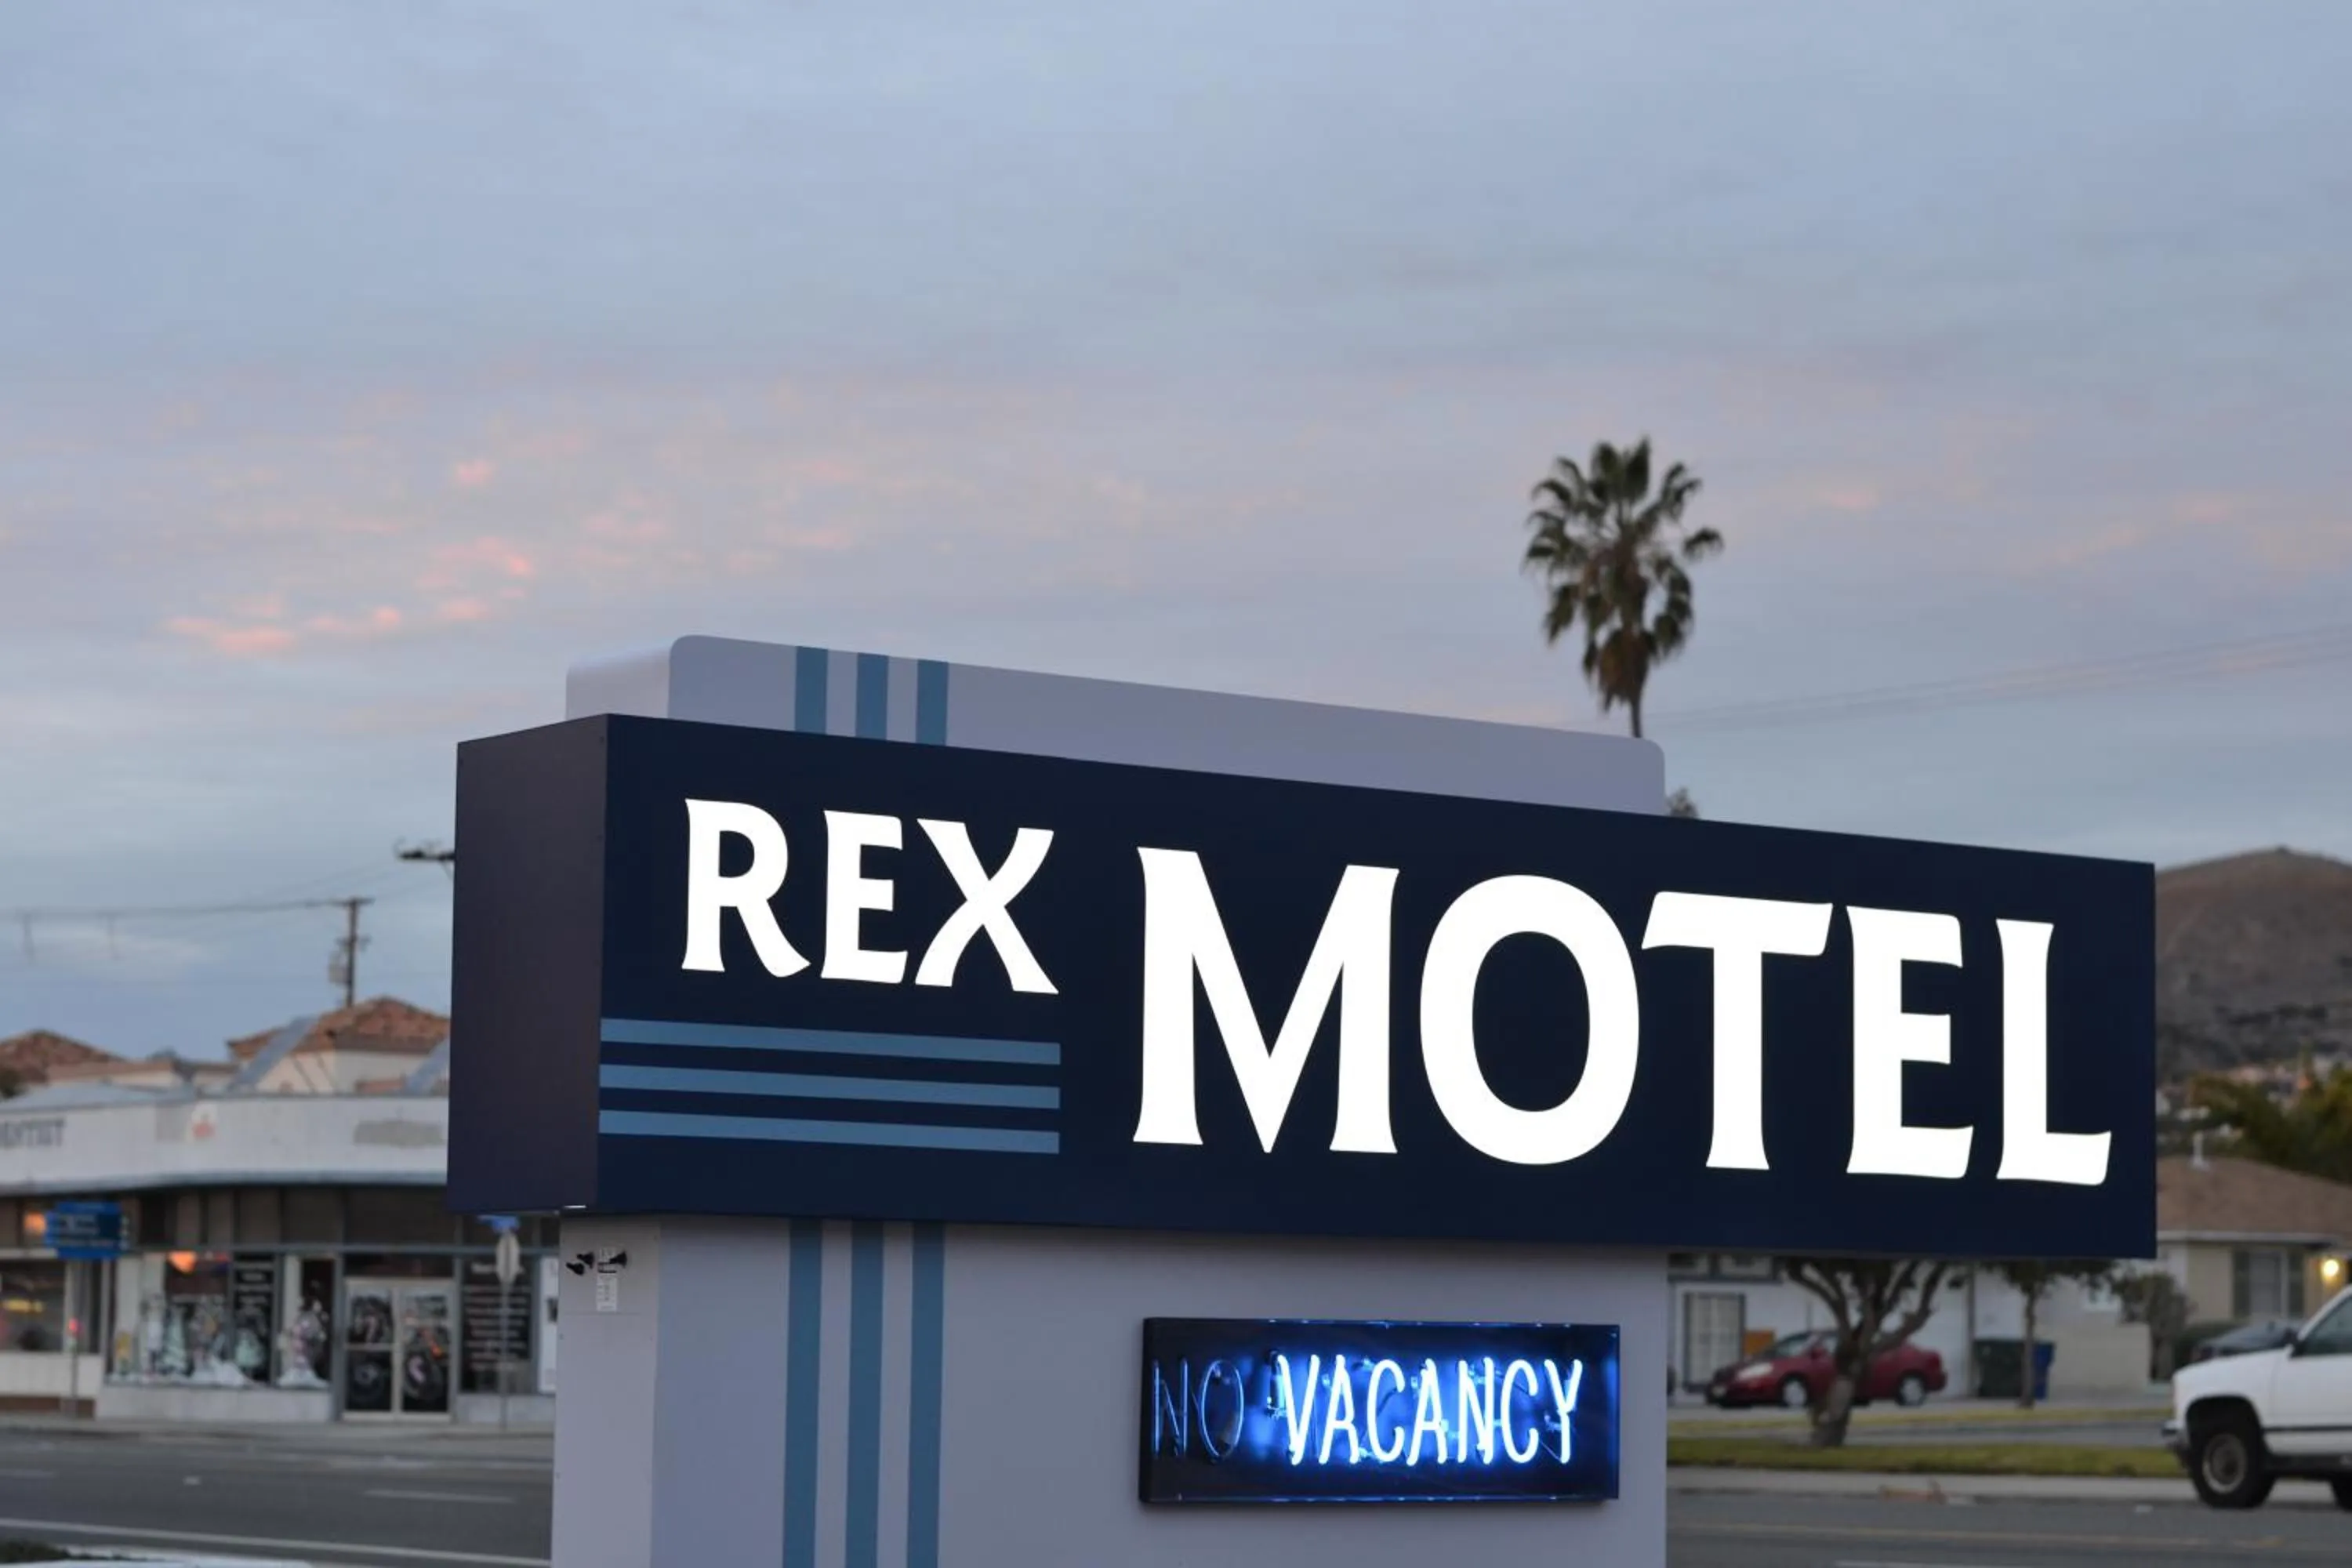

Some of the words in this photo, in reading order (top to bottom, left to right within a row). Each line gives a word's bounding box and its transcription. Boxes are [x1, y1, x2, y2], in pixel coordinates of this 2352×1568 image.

[682, 798, 1059, 994] REX
[1133, 847, 2111, 1185] MOTEL
[1152, 1359, 1245, 1459] NO
[1276, 1352, 1584, 1466] VACANCY
